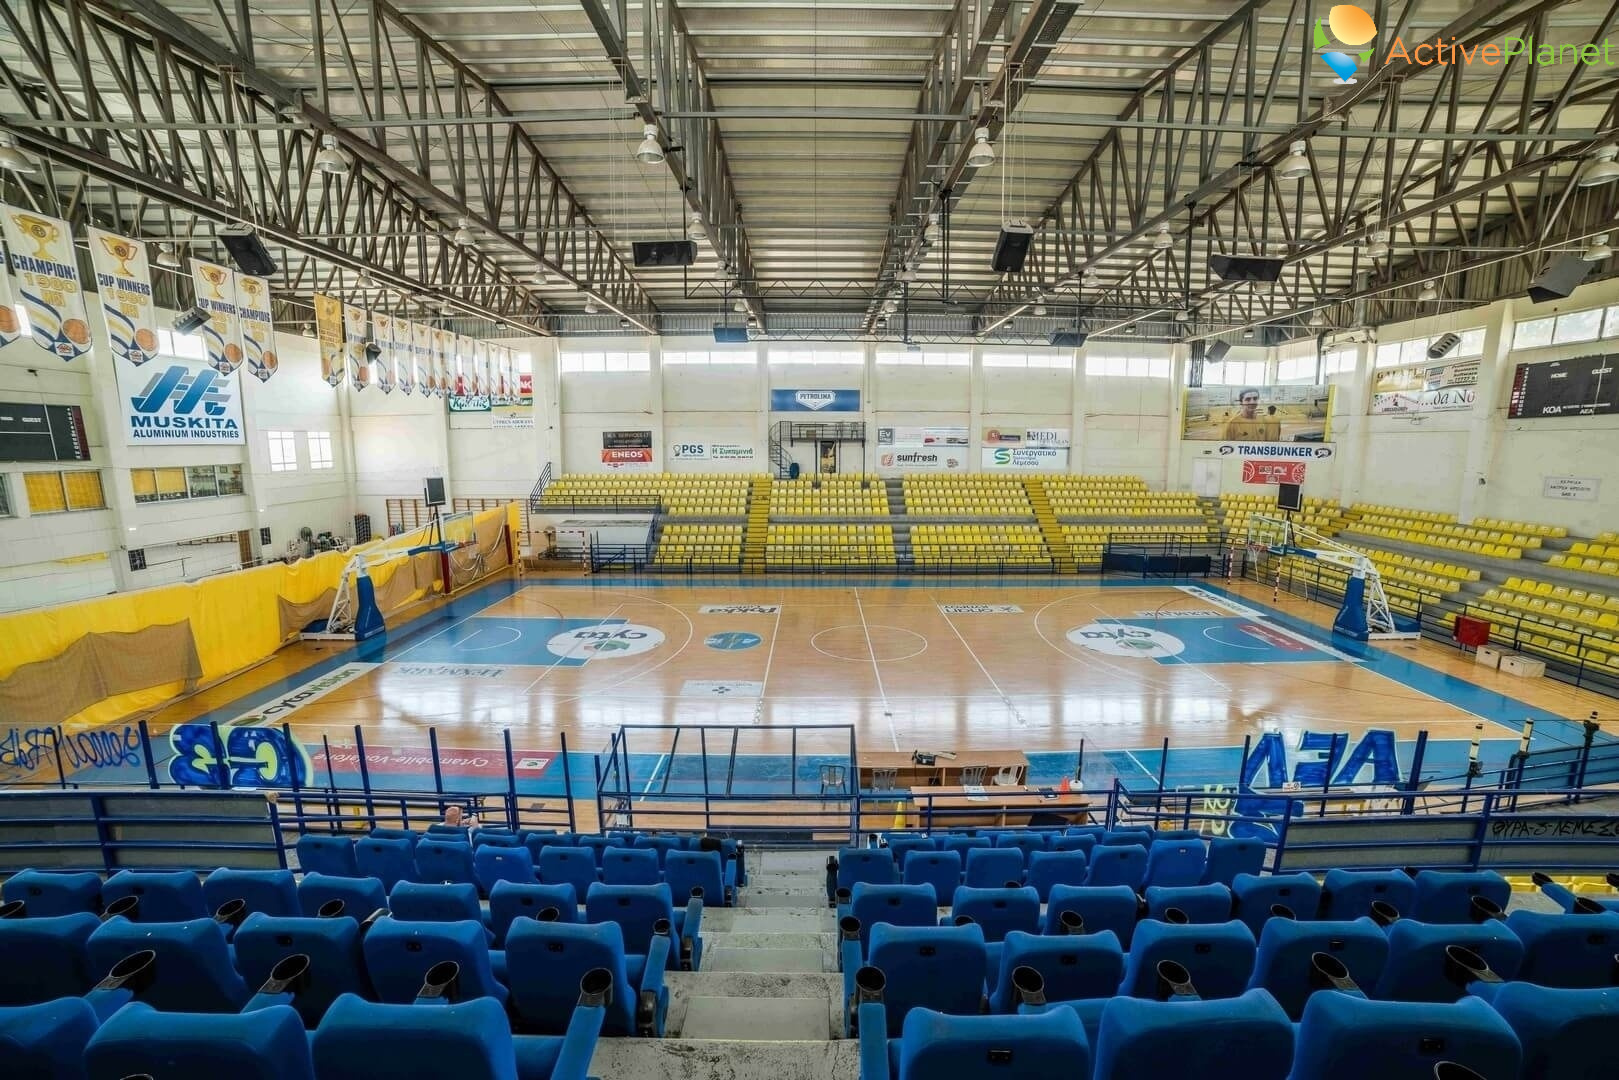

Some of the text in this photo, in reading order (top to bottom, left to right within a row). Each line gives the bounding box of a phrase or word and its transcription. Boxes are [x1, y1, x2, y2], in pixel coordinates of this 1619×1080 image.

[97, 273, 151, 296] CUP WINNERS
[210, 300, 236, 315] WINNERS
[130, 415, 238, 429] MUSKITA
[133, 428, 240, 438] ALUMINIUM INDUSTRIES
[682, 445, 704, 454] PGS
[1238, 445, 1312, 457] TRANSBUNKER
[897, 452, 938, 462] sunfresh
[574, 629, 648, 640] cyta
[1080, 628, 1152, 640] cyta
[262, 668, 361, 715] cytavision
